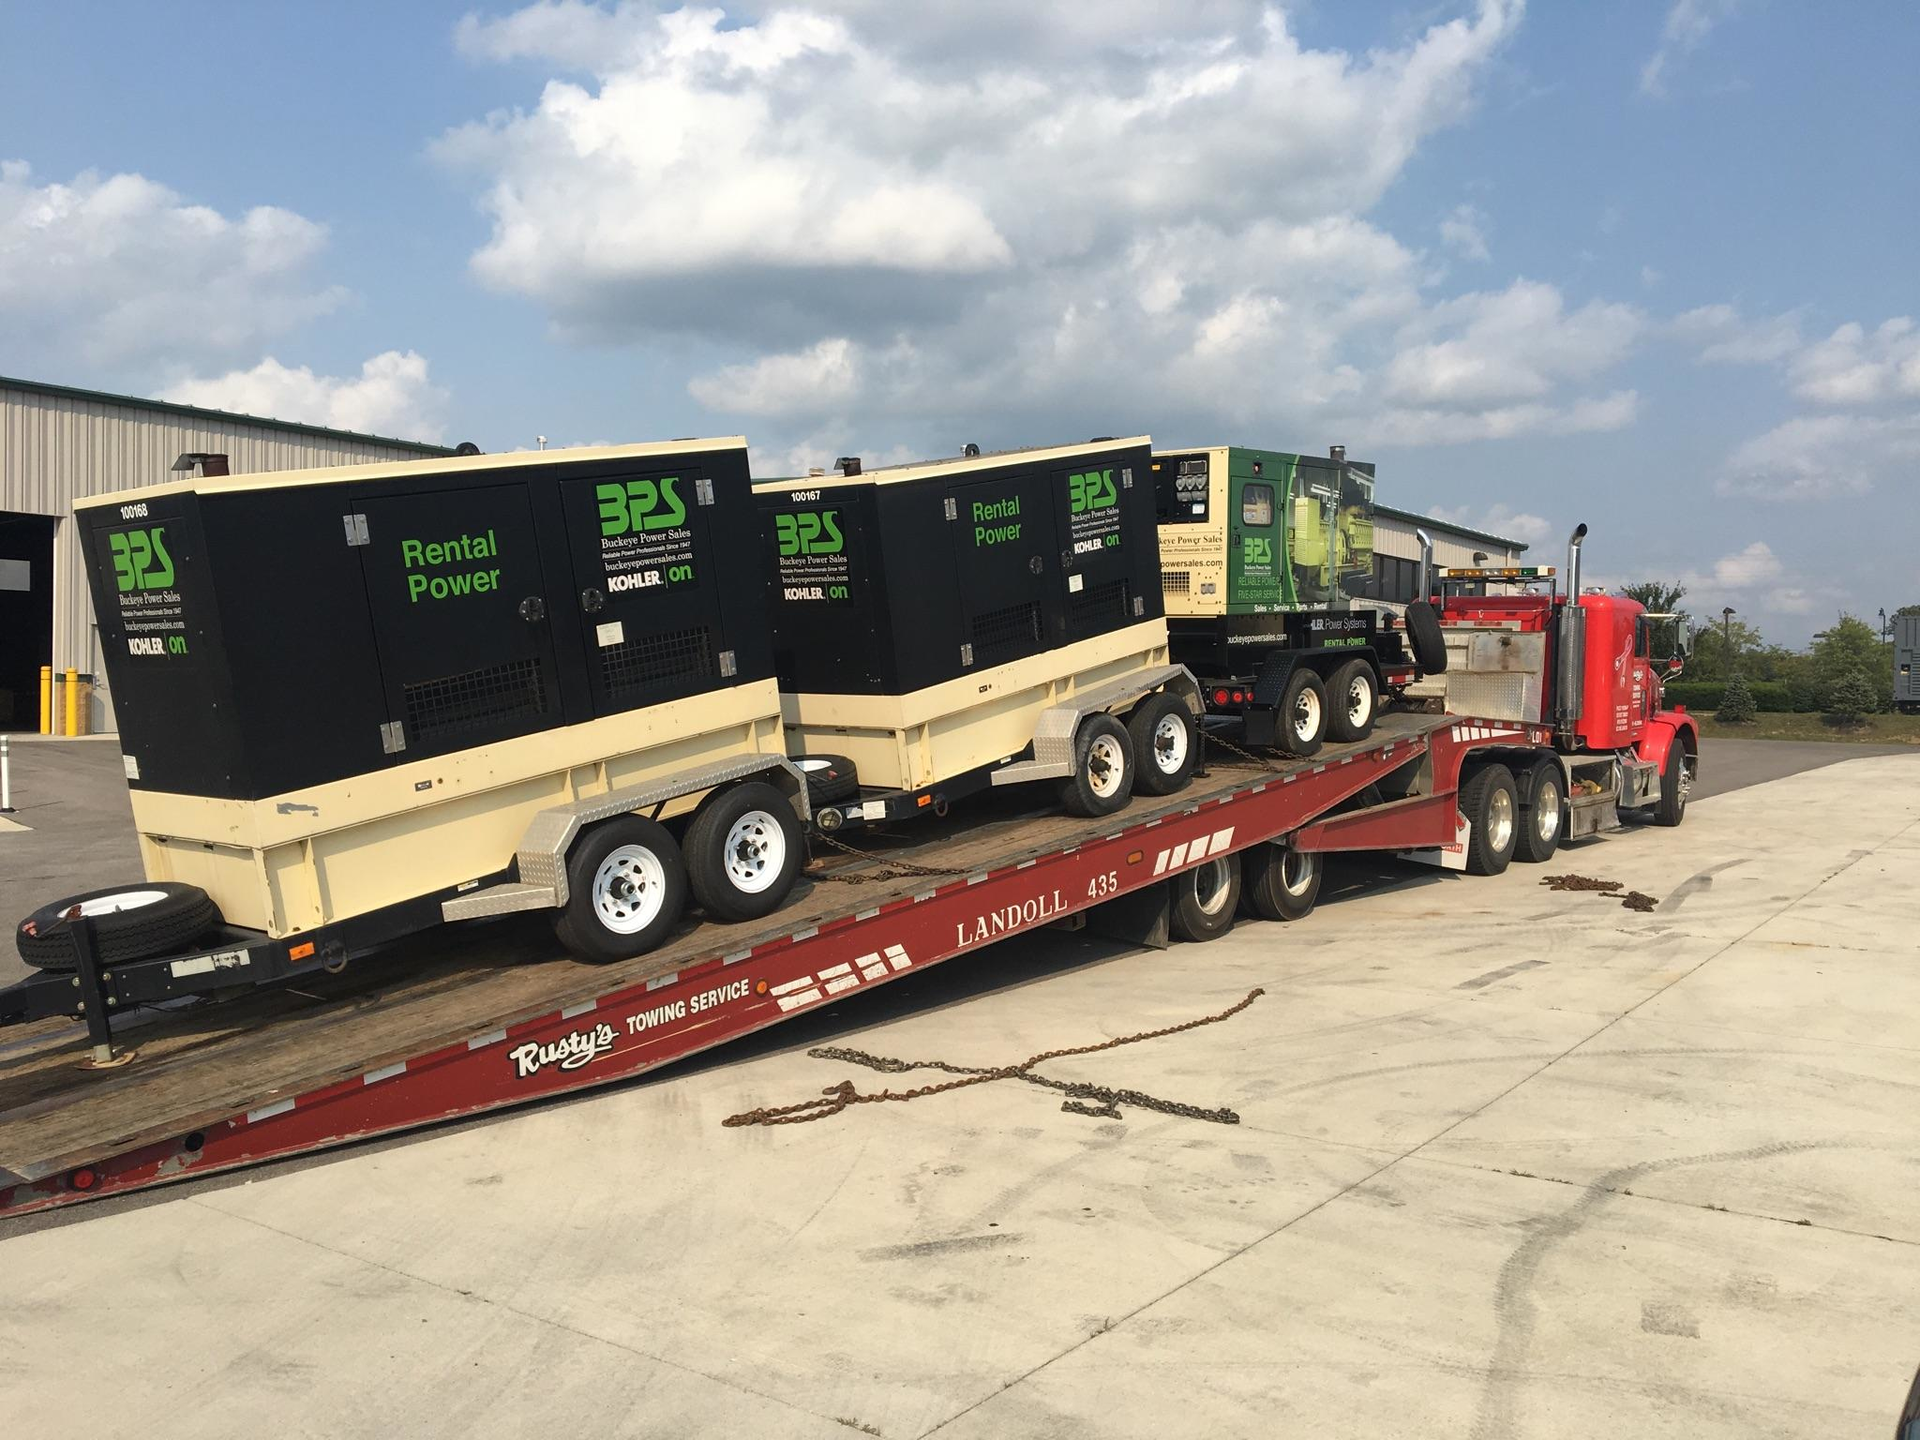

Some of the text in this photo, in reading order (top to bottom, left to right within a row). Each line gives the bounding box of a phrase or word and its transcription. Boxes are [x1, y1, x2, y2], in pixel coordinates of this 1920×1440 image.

[791, 490, 821, 502] 100167
[1069, 469, 1117, 513] BPS
[120, 503, 148, 520] 100168
[596, 477, 686, 536] BPS
[973, 495, 1020, 522] Rental
[601, 528, 691, 549] Buckeye Power Sales
[775, 511, 844, 556] BPS
[975, 523, 1021, 547] Power
[1106, 534, 1120, 547] on
[1177, 536, 1202, 545] Power
[1203, 535, 1223, 543] Sales
[109, 527, 175, 592] BPS
[401, 529, 497, 568] Rental
[1244, 537, 1272, 563] BPS
[604, 552, 693, 571] buckeyepowersales.com
[779, 554, 848, 566] Buckeye Power Sales
[1160, 559, 1223, 569] powersales.com
[407, 568, 500, 603] Power
[607, 564, 692, 593] KOHLER on
[119, 590, 181, 607] Buckeye Power Sales
[784, 585, 848, 600] KOHLER on
[1253, 604, 1268, 613] Sales
[1273, 603, 1290, 612] Service
[1313, 602, 1328, 610] Rental
[1325, 617, 1343, 630] Power
[1343, 617, 1367, 632] Systems
[128, 636, 188, 656] KOHLER on
[1324, 637, 1366, 648] RENTAL POWER
[1087, 871, 1118, 899] 435
[956, 889, 1068, 948] LANDOLL
[626, 978, 750, 1036] TOWING SERVICE
[509, 1022, 620, 1077] Rusty's
